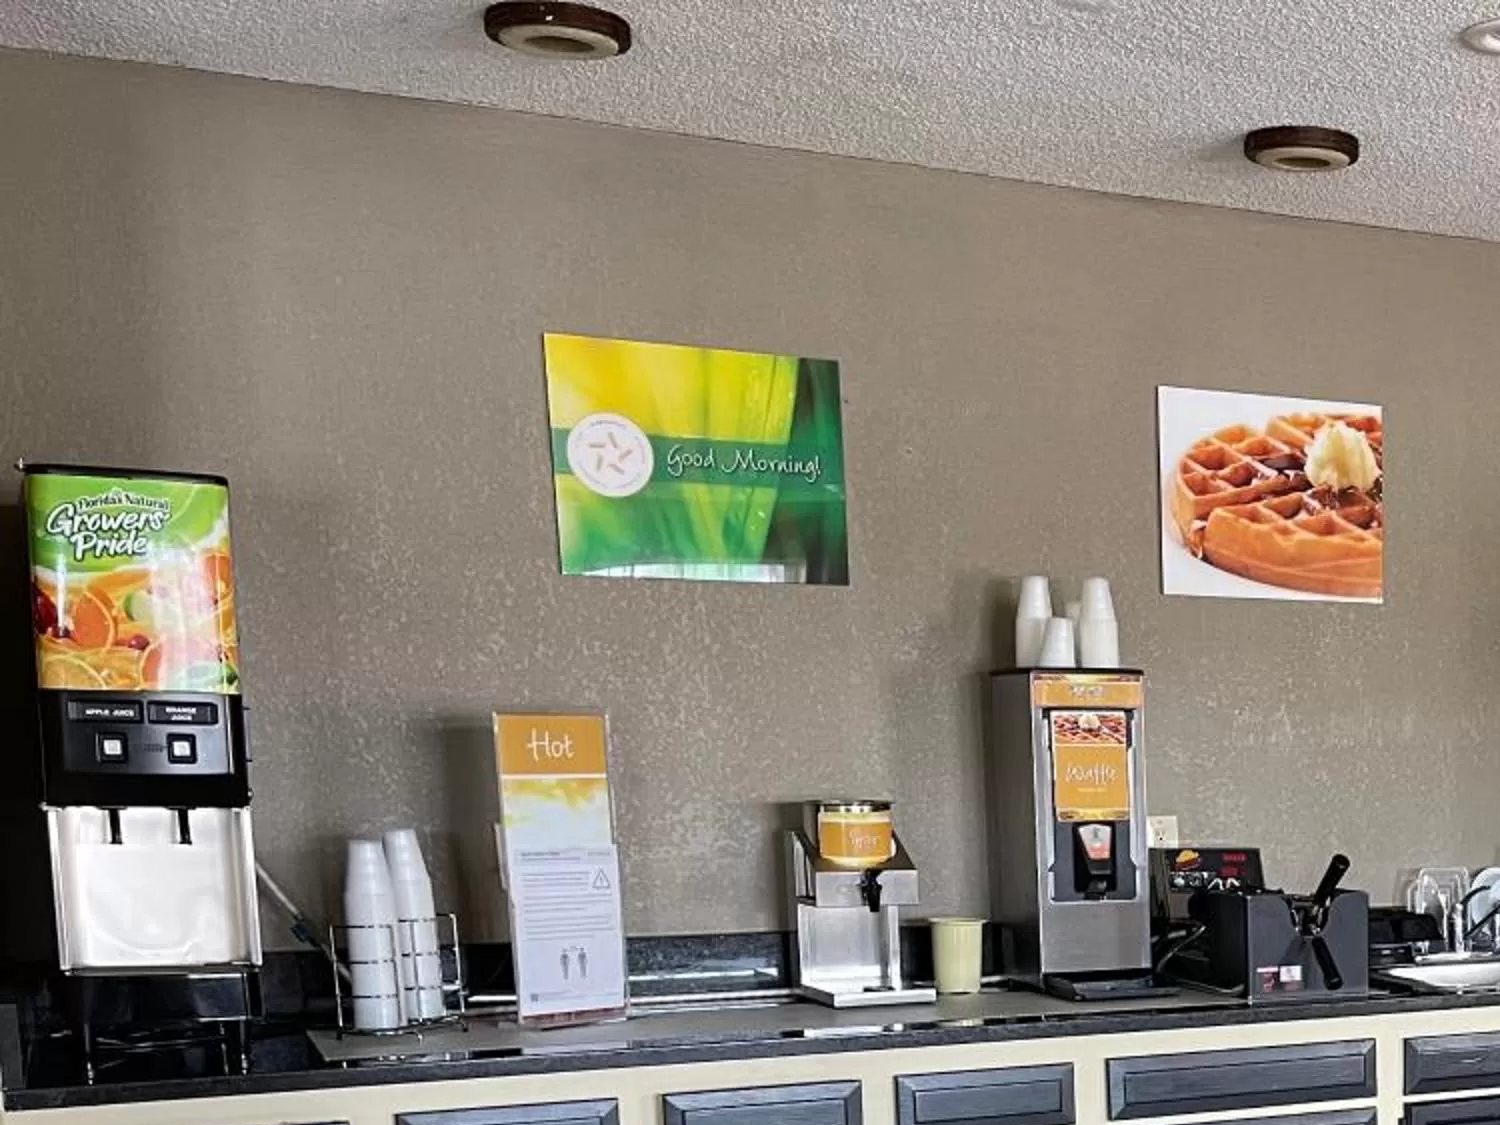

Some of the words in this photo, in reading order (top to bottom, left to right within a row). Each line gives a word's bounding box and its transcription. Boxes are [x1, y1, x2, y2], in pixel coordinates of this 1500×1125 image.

[667, 443, 715, 477] Good
[721, 448, 821, 483] Morning!
[69, 529, 148, 561] Pride
[526, 728, 575, 761] Hot
